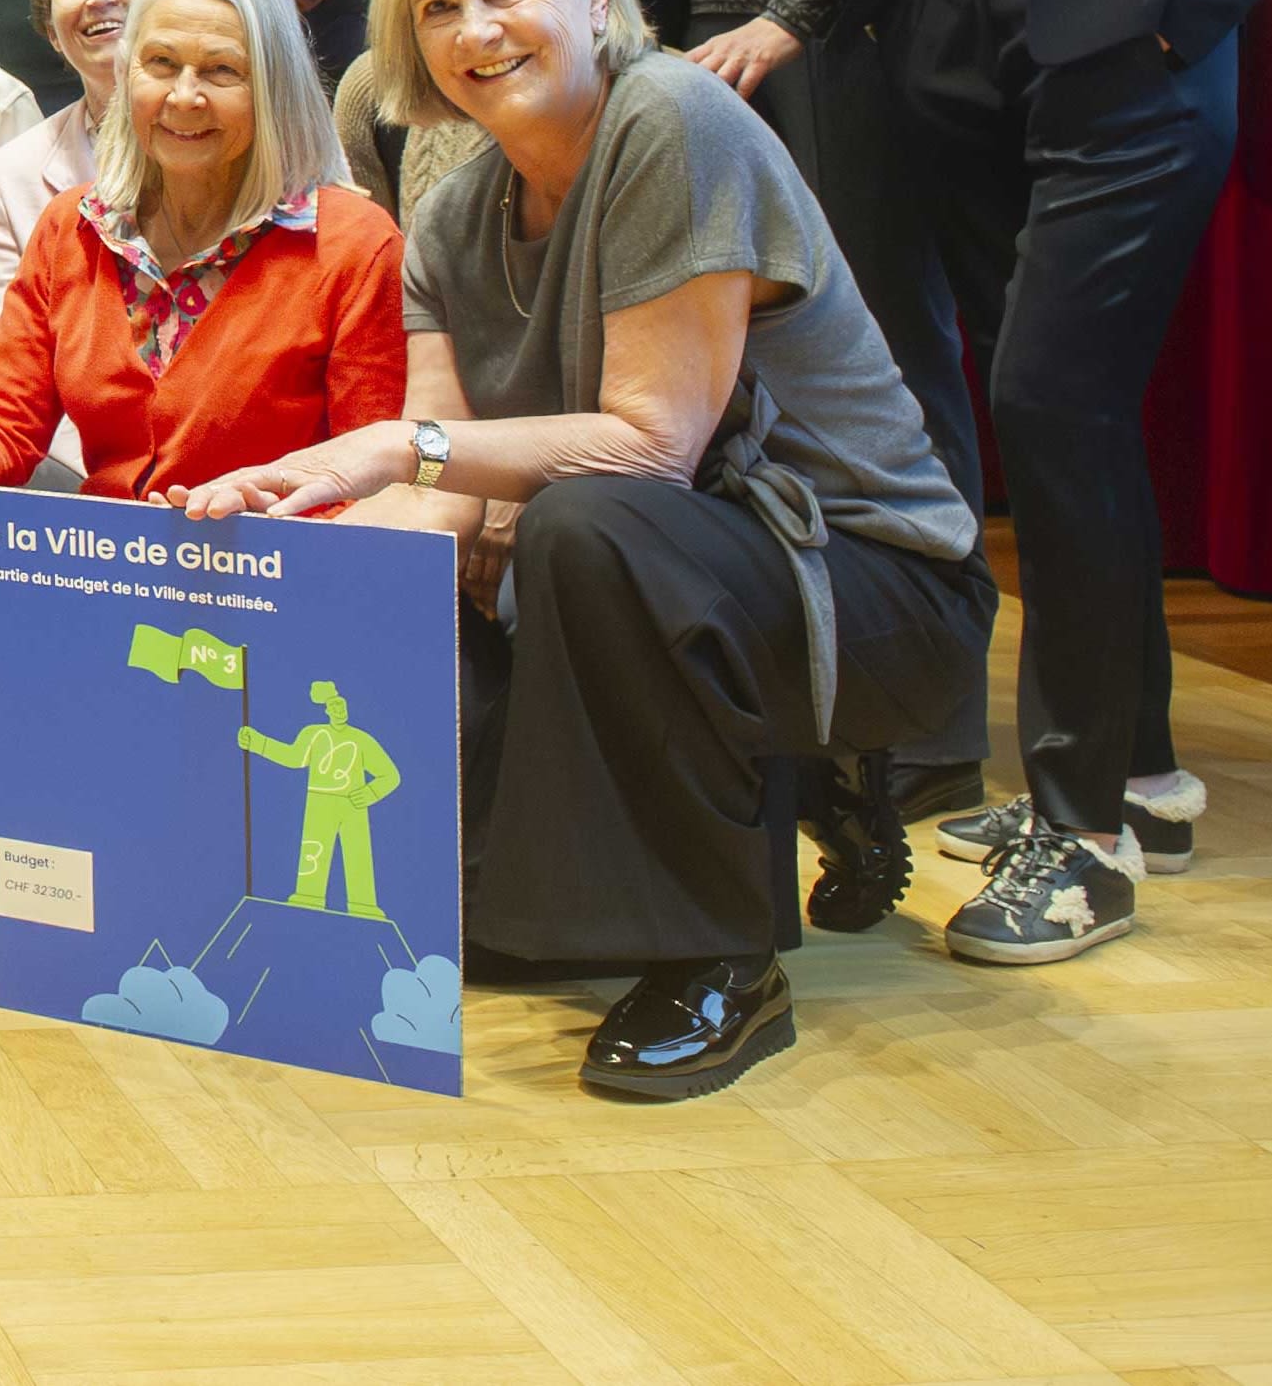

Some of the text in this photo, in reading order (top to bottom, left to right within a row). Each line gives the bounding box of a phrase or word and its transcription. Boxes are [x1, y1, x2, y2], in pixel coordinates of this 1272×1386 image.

[8, 522, 36, 551] la
[45, 528, 116, 560] Ville
[125, 536, 167, 565] de
[177, 543, 281, 578] Gland
[31, 572, 51, 585] du
[55, 574, 109, 594] budget
[112, 582, 131, 594] de
[135, 583, 149, 596] la
[153, 586, 185, 601] Ville
[189, 592, 213, 604] est
[217, 594, 277, 612] utilisée.
[223, 653, 237, 673] 3
[5, 880, 29, 892] CHF
